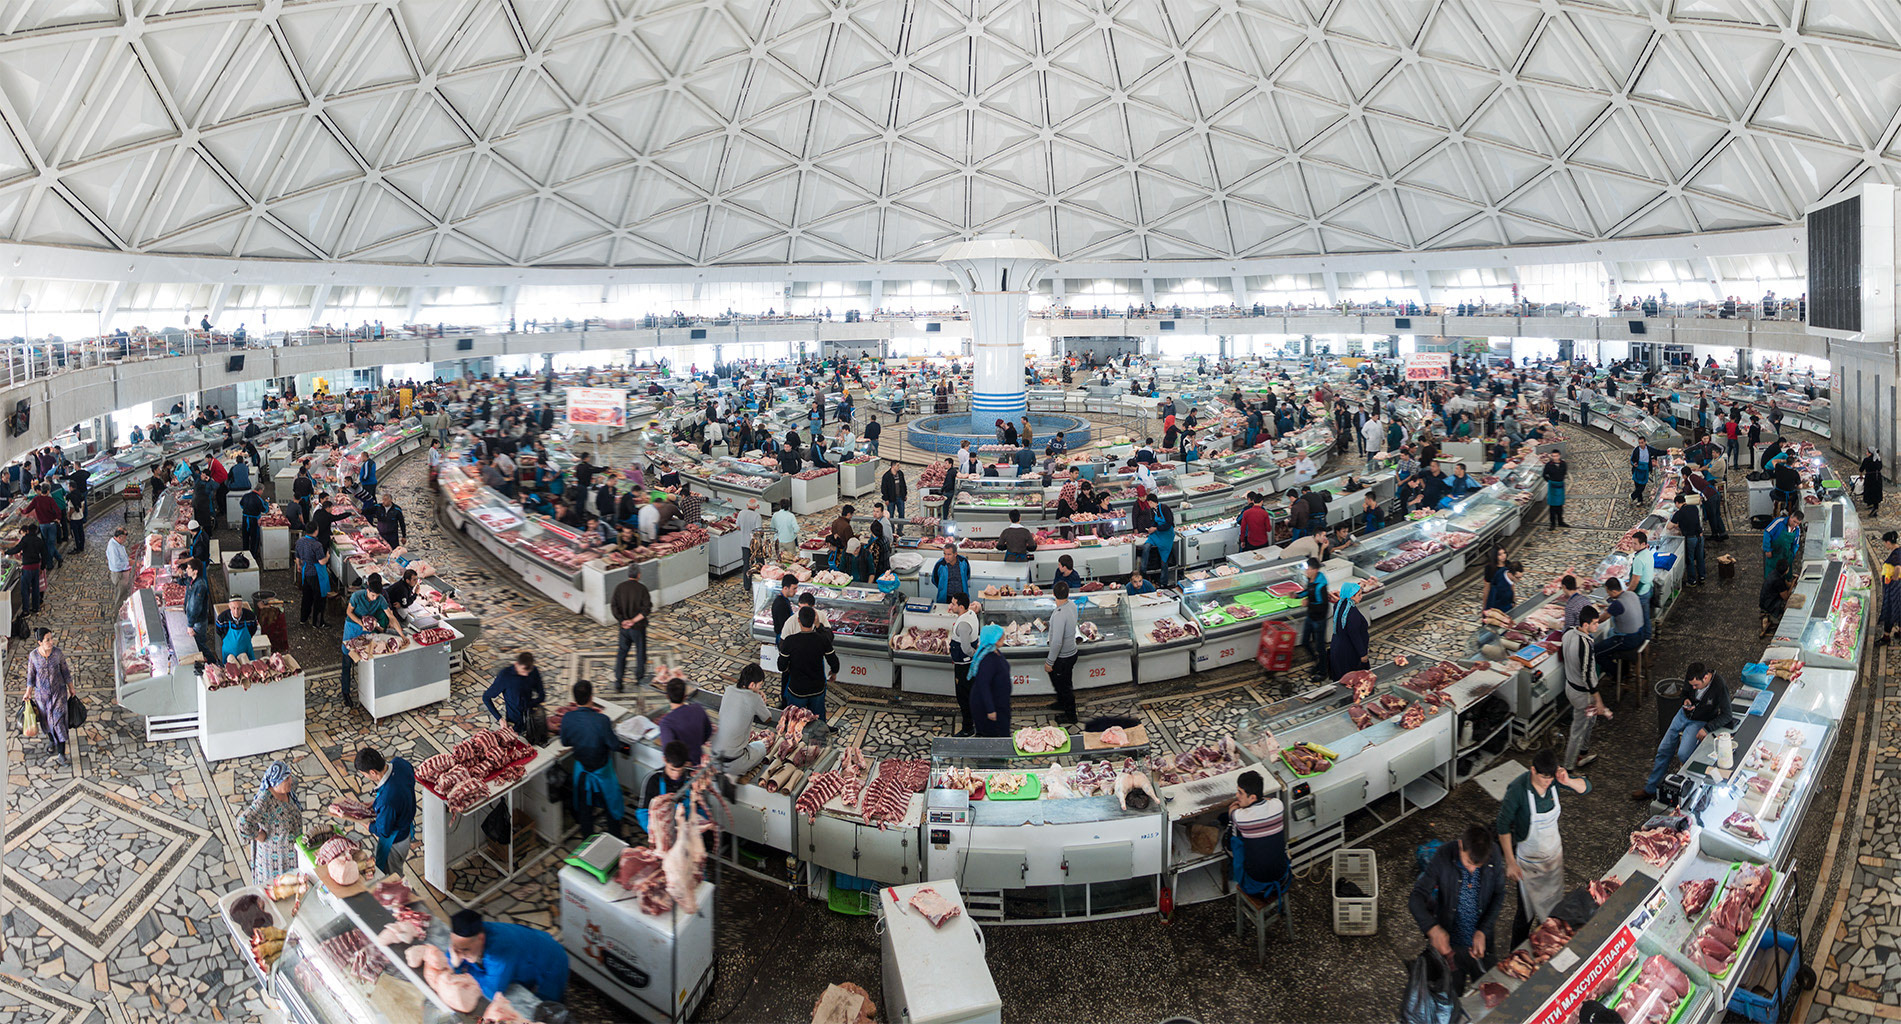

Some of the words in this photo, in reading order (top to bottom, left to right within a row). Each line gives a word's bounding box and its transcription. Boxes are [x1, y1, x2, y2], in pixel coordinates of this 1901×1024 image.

[401, 597, 408, 606] 3
[1220, 647, 1235, 659] 293
[850, 665, 867, 676] 290
[1089, 667, 1106, 678] 292
[1013, 675, 1030, 685] 291
[1561, 937, 1627, 1011] МАХСУЛОТЛАРИ
